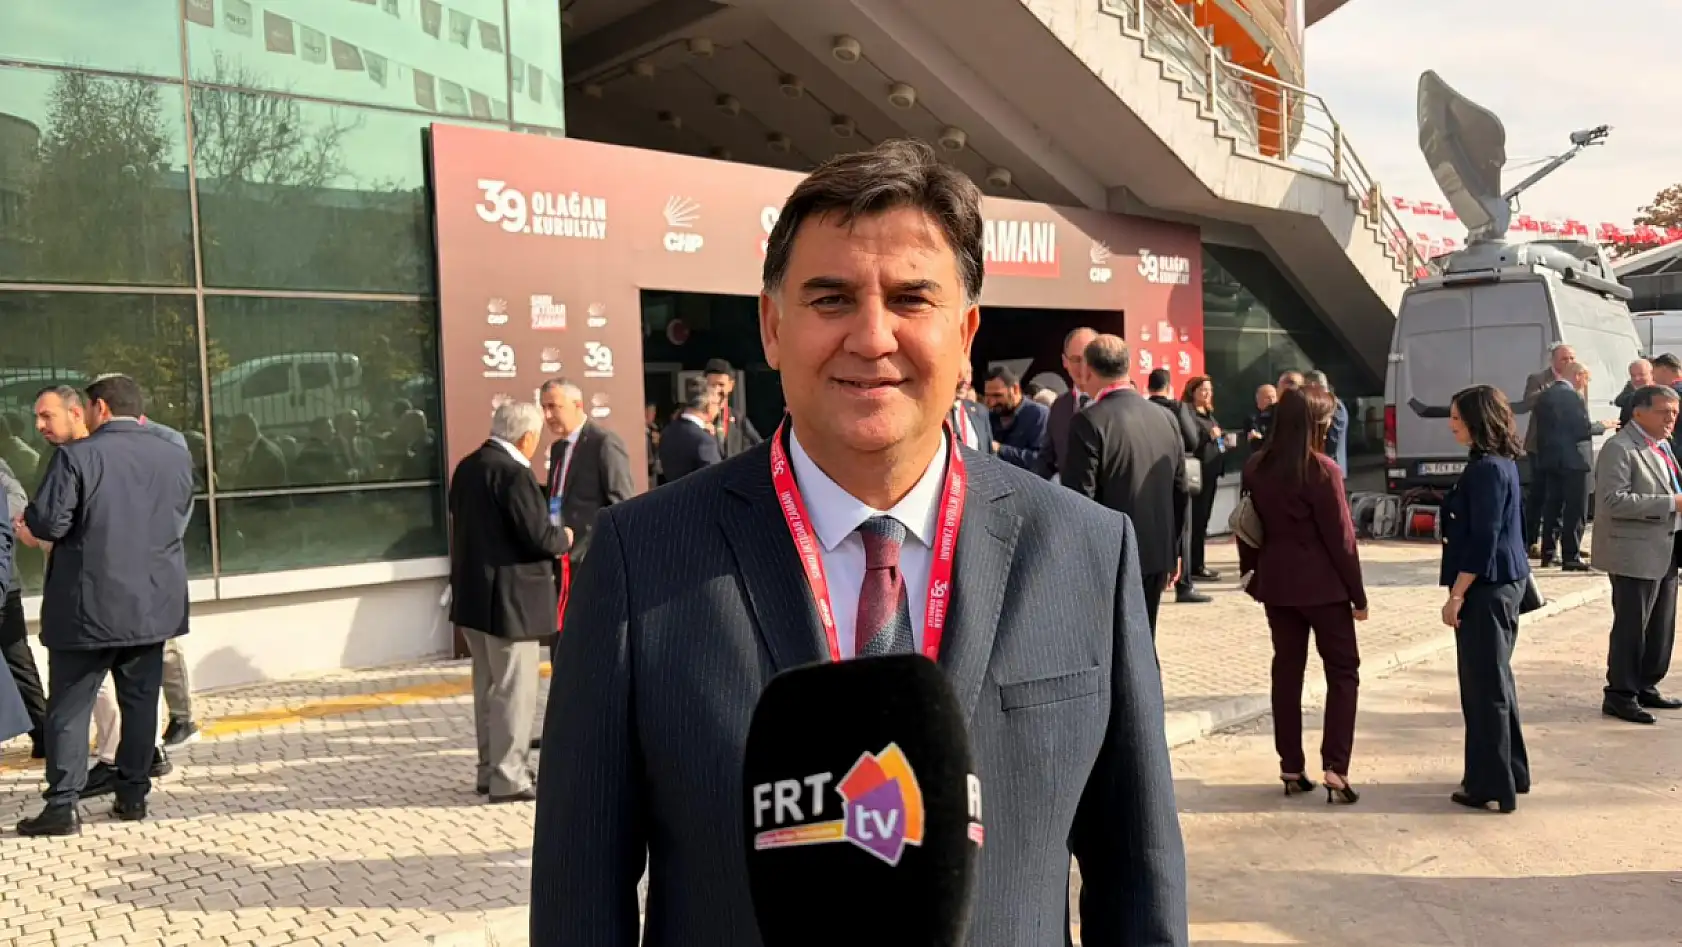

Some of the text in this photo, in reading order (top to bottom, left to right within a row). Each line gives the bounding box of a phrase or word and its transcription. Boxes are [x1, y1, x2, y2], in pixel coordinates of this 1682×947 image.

[475, 179, 606, 233] 39. OLAĞAN
[532, 216, 606, 239] KURULTAY
[663, 232, 704, 253] CHP
[983, 220, 1056, 264] AMANI
[753, 771, 833, 828] FRT
[855, 804, 899, 840] tv
